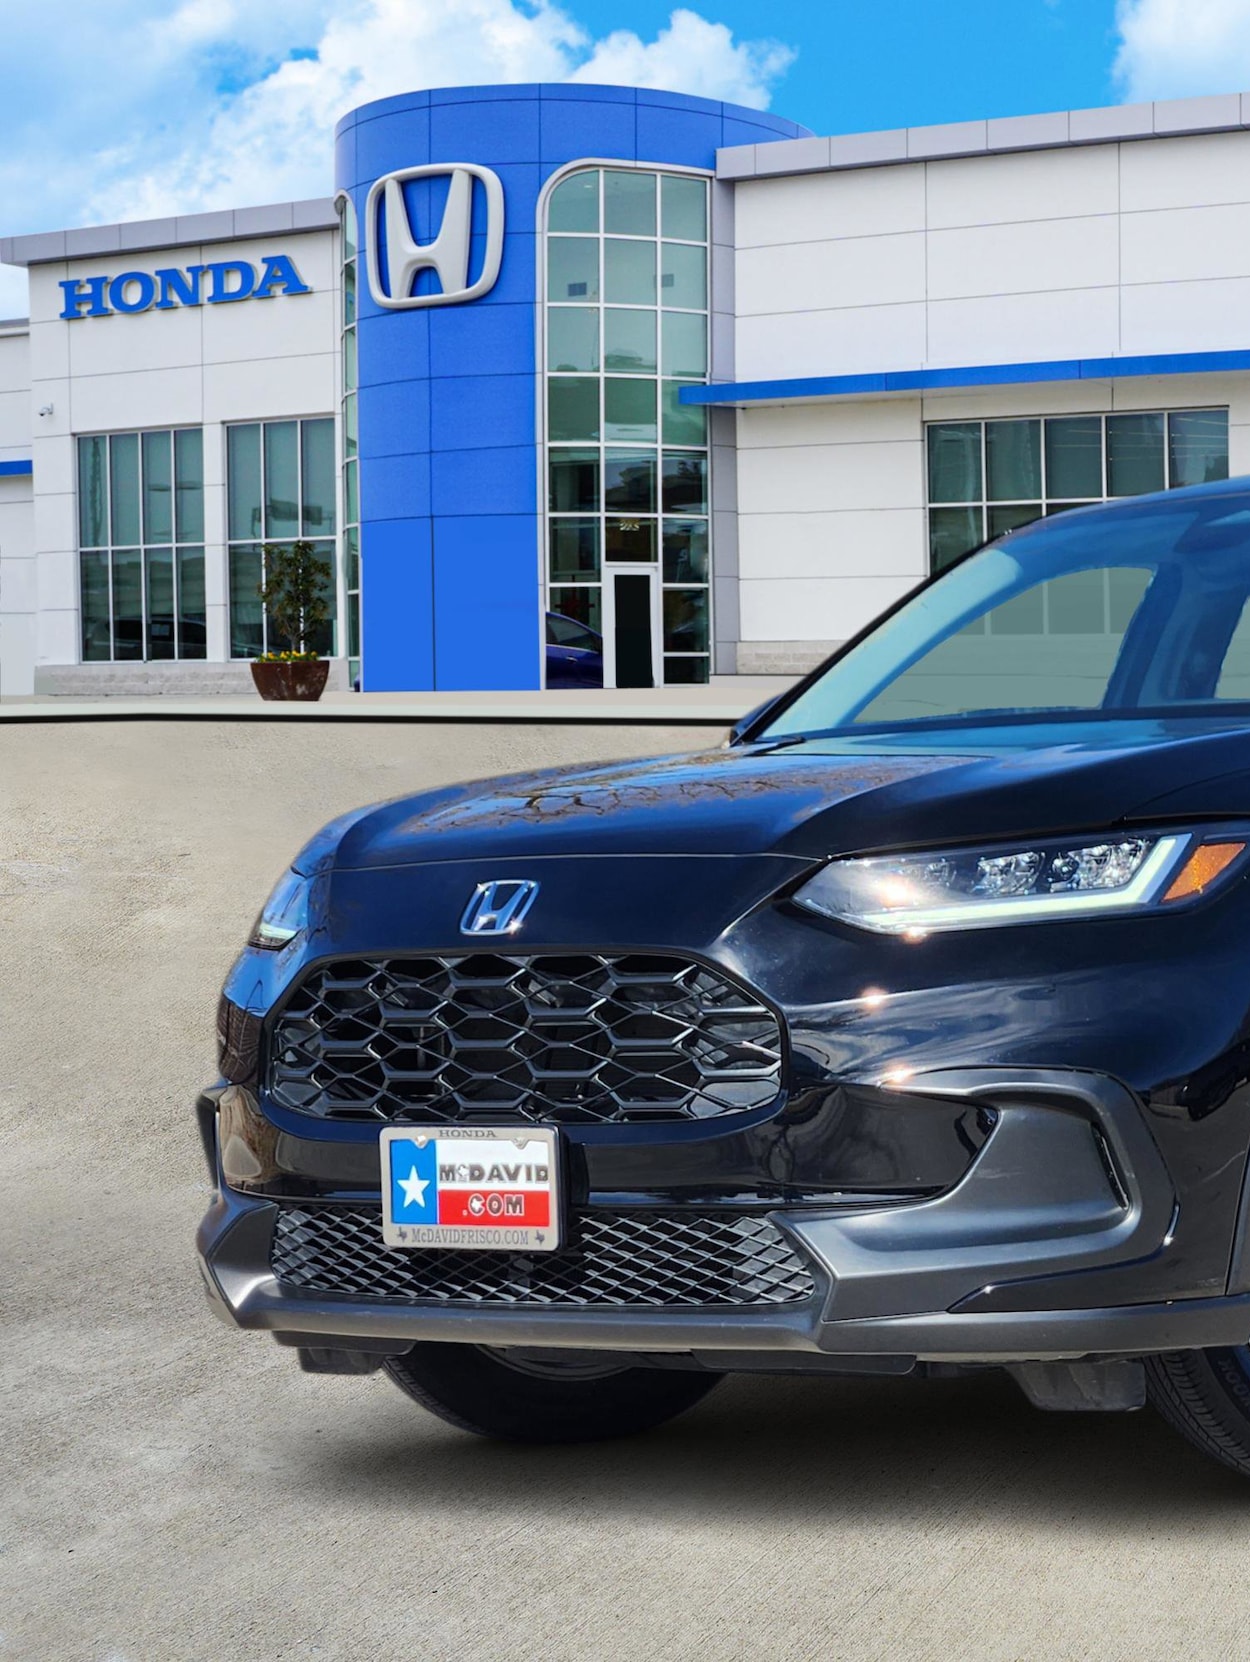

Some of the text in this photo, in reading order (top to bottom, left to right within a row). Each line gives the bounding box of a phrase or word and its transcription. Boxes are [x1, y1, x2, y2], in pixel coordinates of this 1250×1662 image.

[58, 254, 310, 319] HONDA
[438, 1129, 498, 1138] HONDA
[411, 1229, 529, 1245] McDAVIDFRISCO.COM
